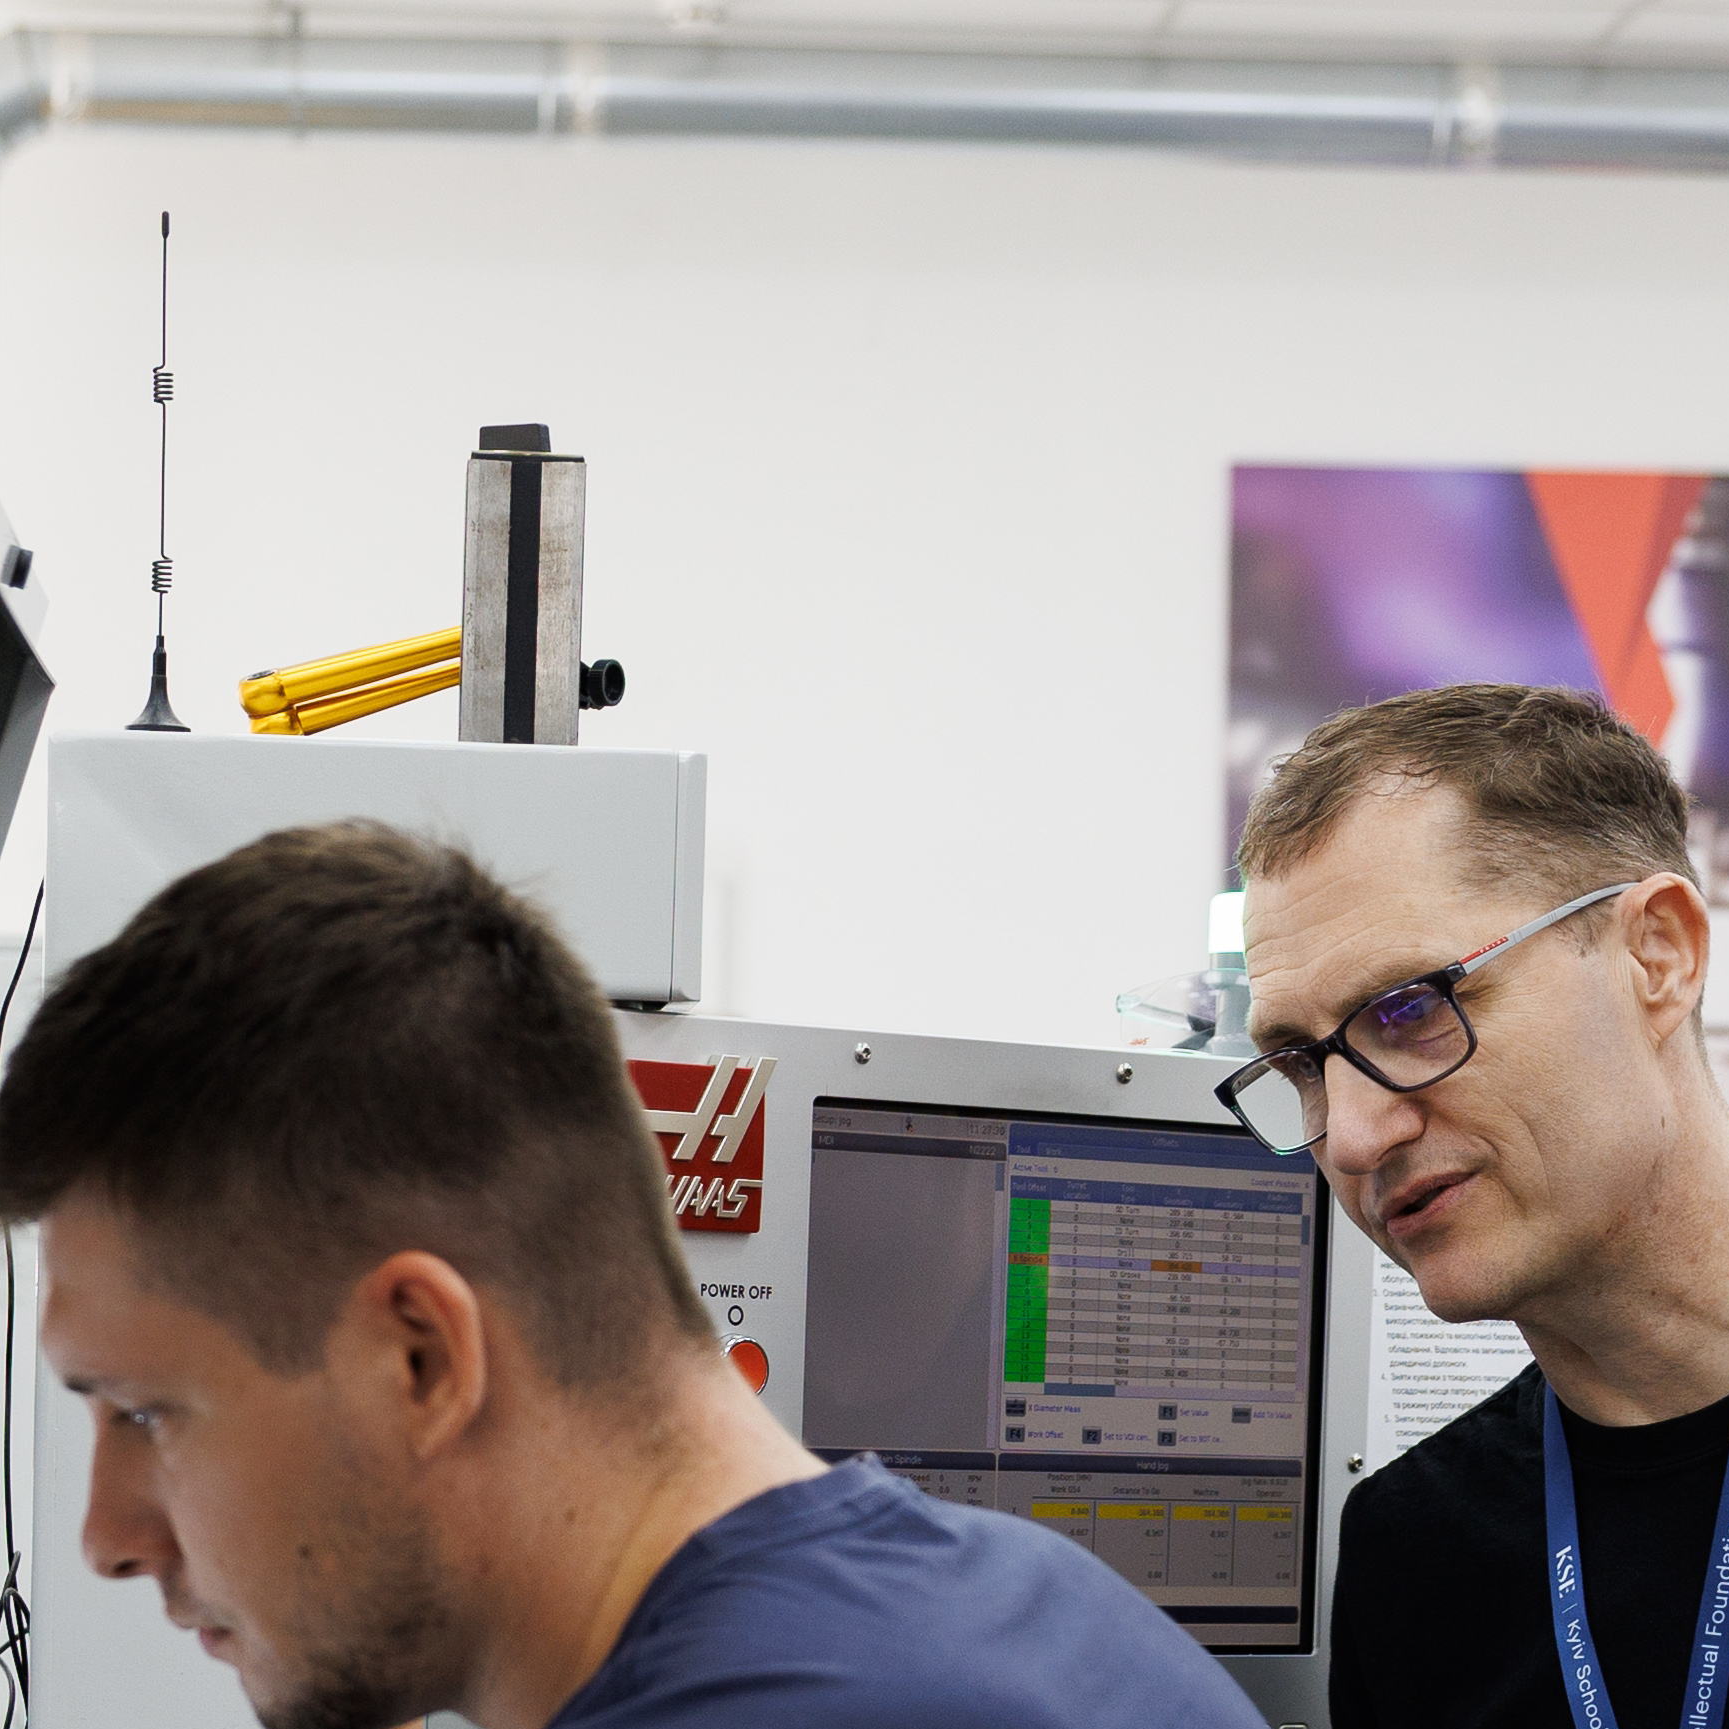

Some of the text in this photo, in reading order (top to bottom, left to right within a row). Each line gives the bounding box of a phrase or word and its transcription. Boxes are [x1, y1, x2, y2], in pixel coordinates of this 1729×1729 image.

[700, 1283, 773, 1300] POWER OFF
[1009, 1428, 1021, 1439] F4
[1086, 1430, 1098, 1441] F2
[1555, 1545, 1576, 1599] KSE
[1566, 1618, 1586, 1661] Kyiv
